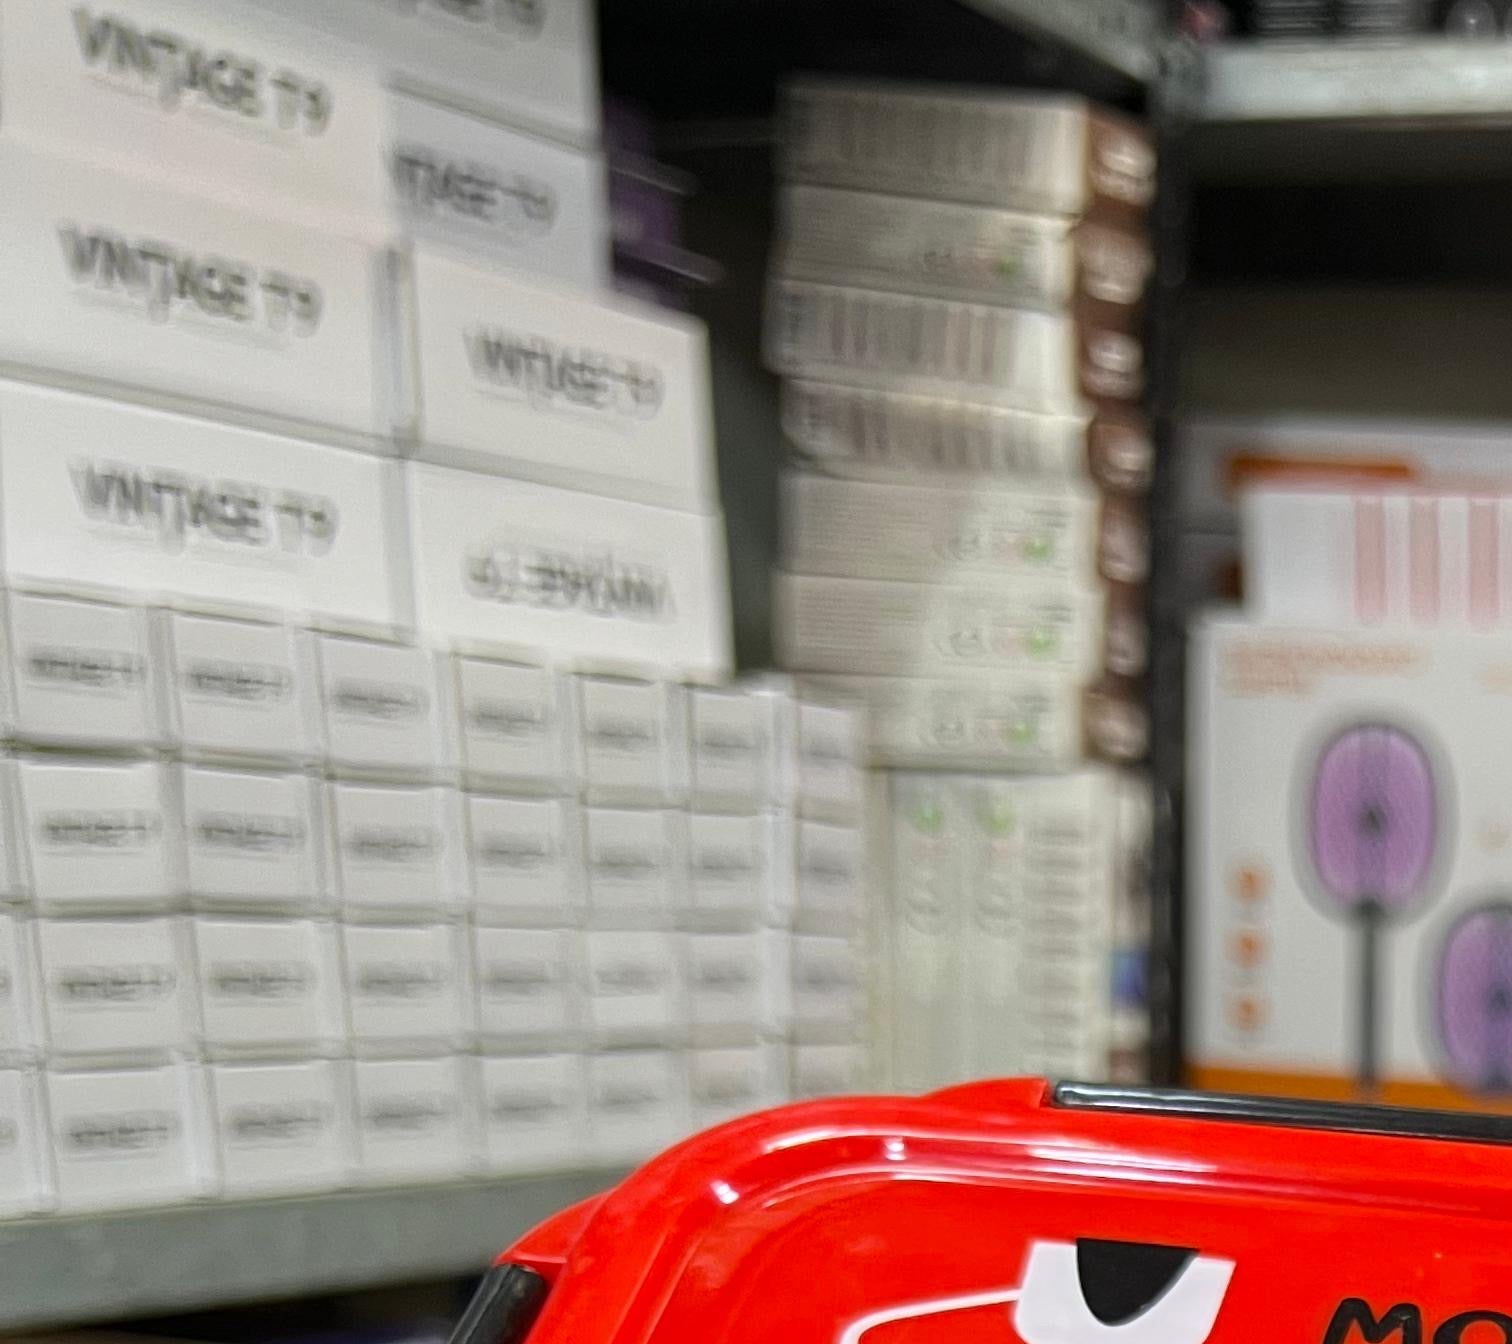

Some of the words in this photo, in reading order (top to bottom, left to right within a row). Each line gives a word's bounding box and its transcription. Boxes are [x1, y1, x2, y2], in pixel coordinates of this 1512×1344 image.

[71, 7, 260, 118] VINTAGE
[56, 219, 254, 322] VINTAGE
[67, 454, 267, 556] VINTAGE
